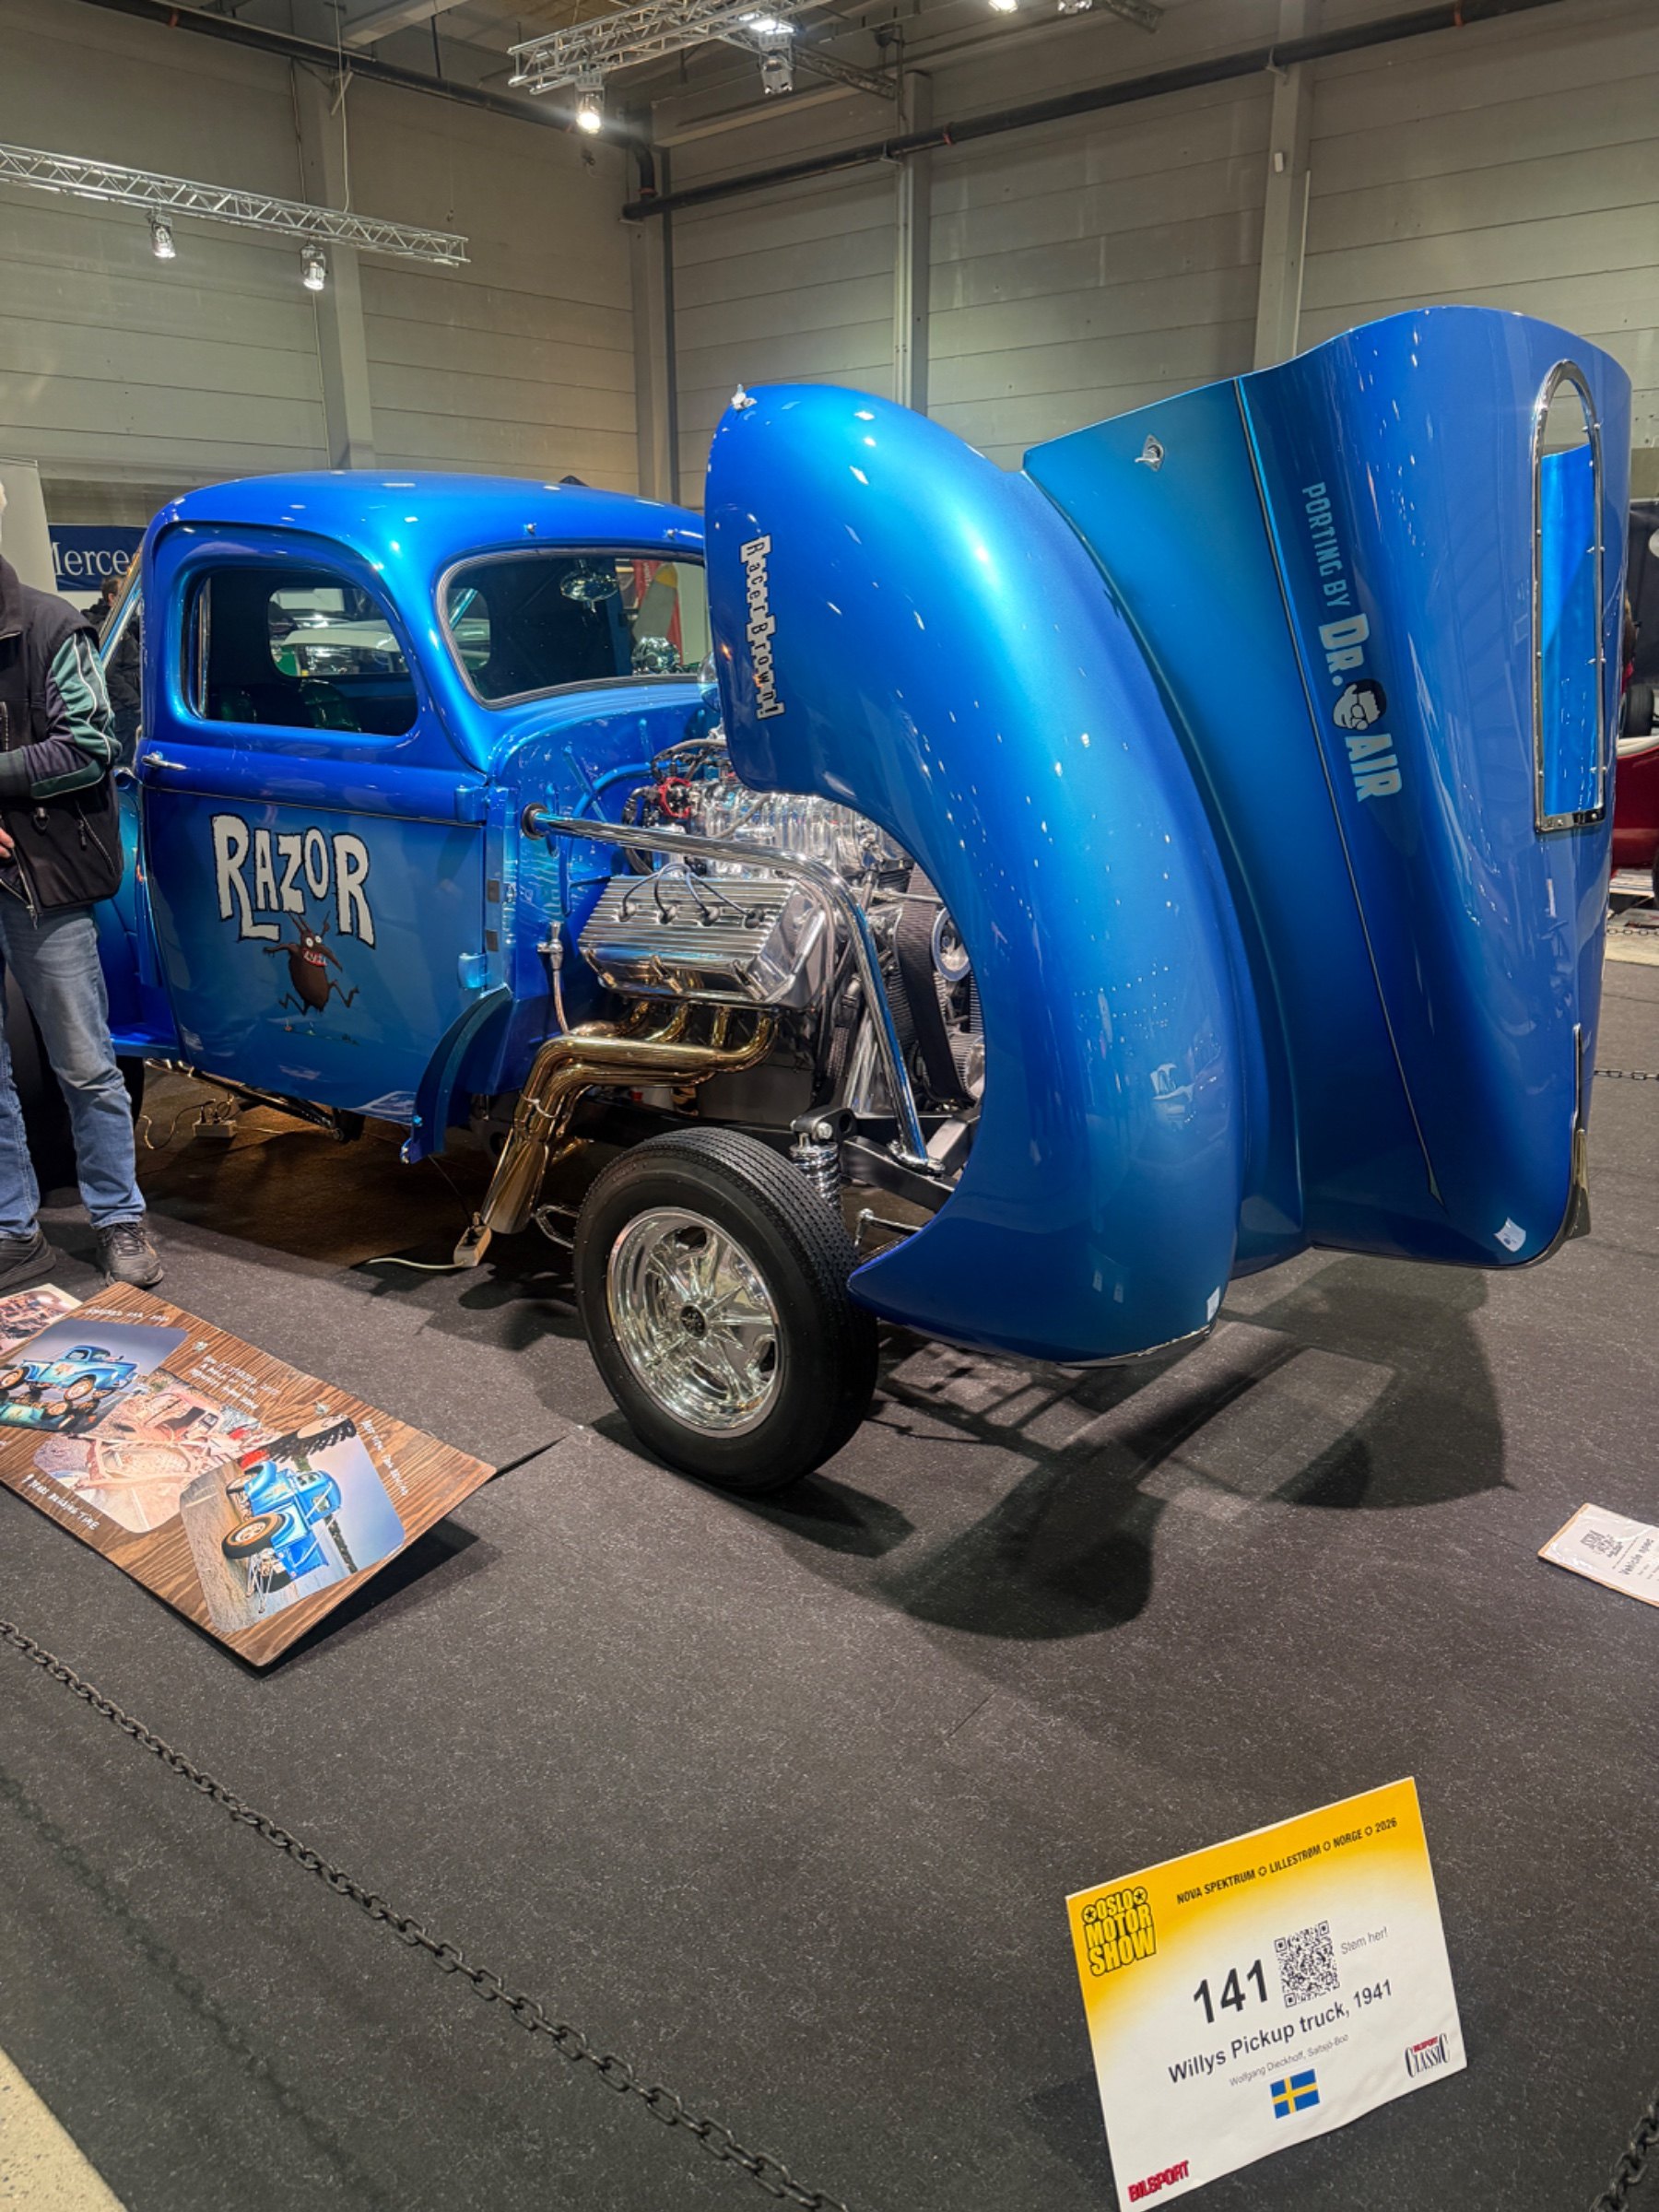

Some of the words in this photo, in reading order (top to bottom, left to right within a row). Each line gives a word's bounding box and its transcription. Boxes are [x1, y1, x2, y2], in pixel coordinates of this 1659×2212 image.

[1302, 482, 1343, 577] PORTING
[1324, 579, 1351, 607] BY
[1345, 733, 1403, 803] AIR
[210, 814, 375, 950] RAZOR
[1177, 1888, 1202, 1904] NOVA
[1204, 1870, 1255, 1895] SPEKTRUM
[1269, 1843, 1322, 1874] LILLESTRØM
[1333, 1829, 1363, 1849] NORGE
[1375, 1818, 1398, 1833] 2026
[1084, 1903, 1153, 1949] MOTOR
[1095, 1888, 1135, 1921] OSLO
[1088, 1926, 1157, 1977] SHOW
[1340, 1936, 1367, 1955] Stem
[1367, 1926, 1388, 1943] her!
[1194, 1959, 1267, 2023] 141
[1168, 2050, 1227, 2084] Willys
[1230, 2024, 1295, 2059] Pickup
[1299, 2001, 1350, 2033] truck,
[1353, 1979, 1392, 2008] 1941
[1127, 2159, 1190, 2202] BILSPORT
